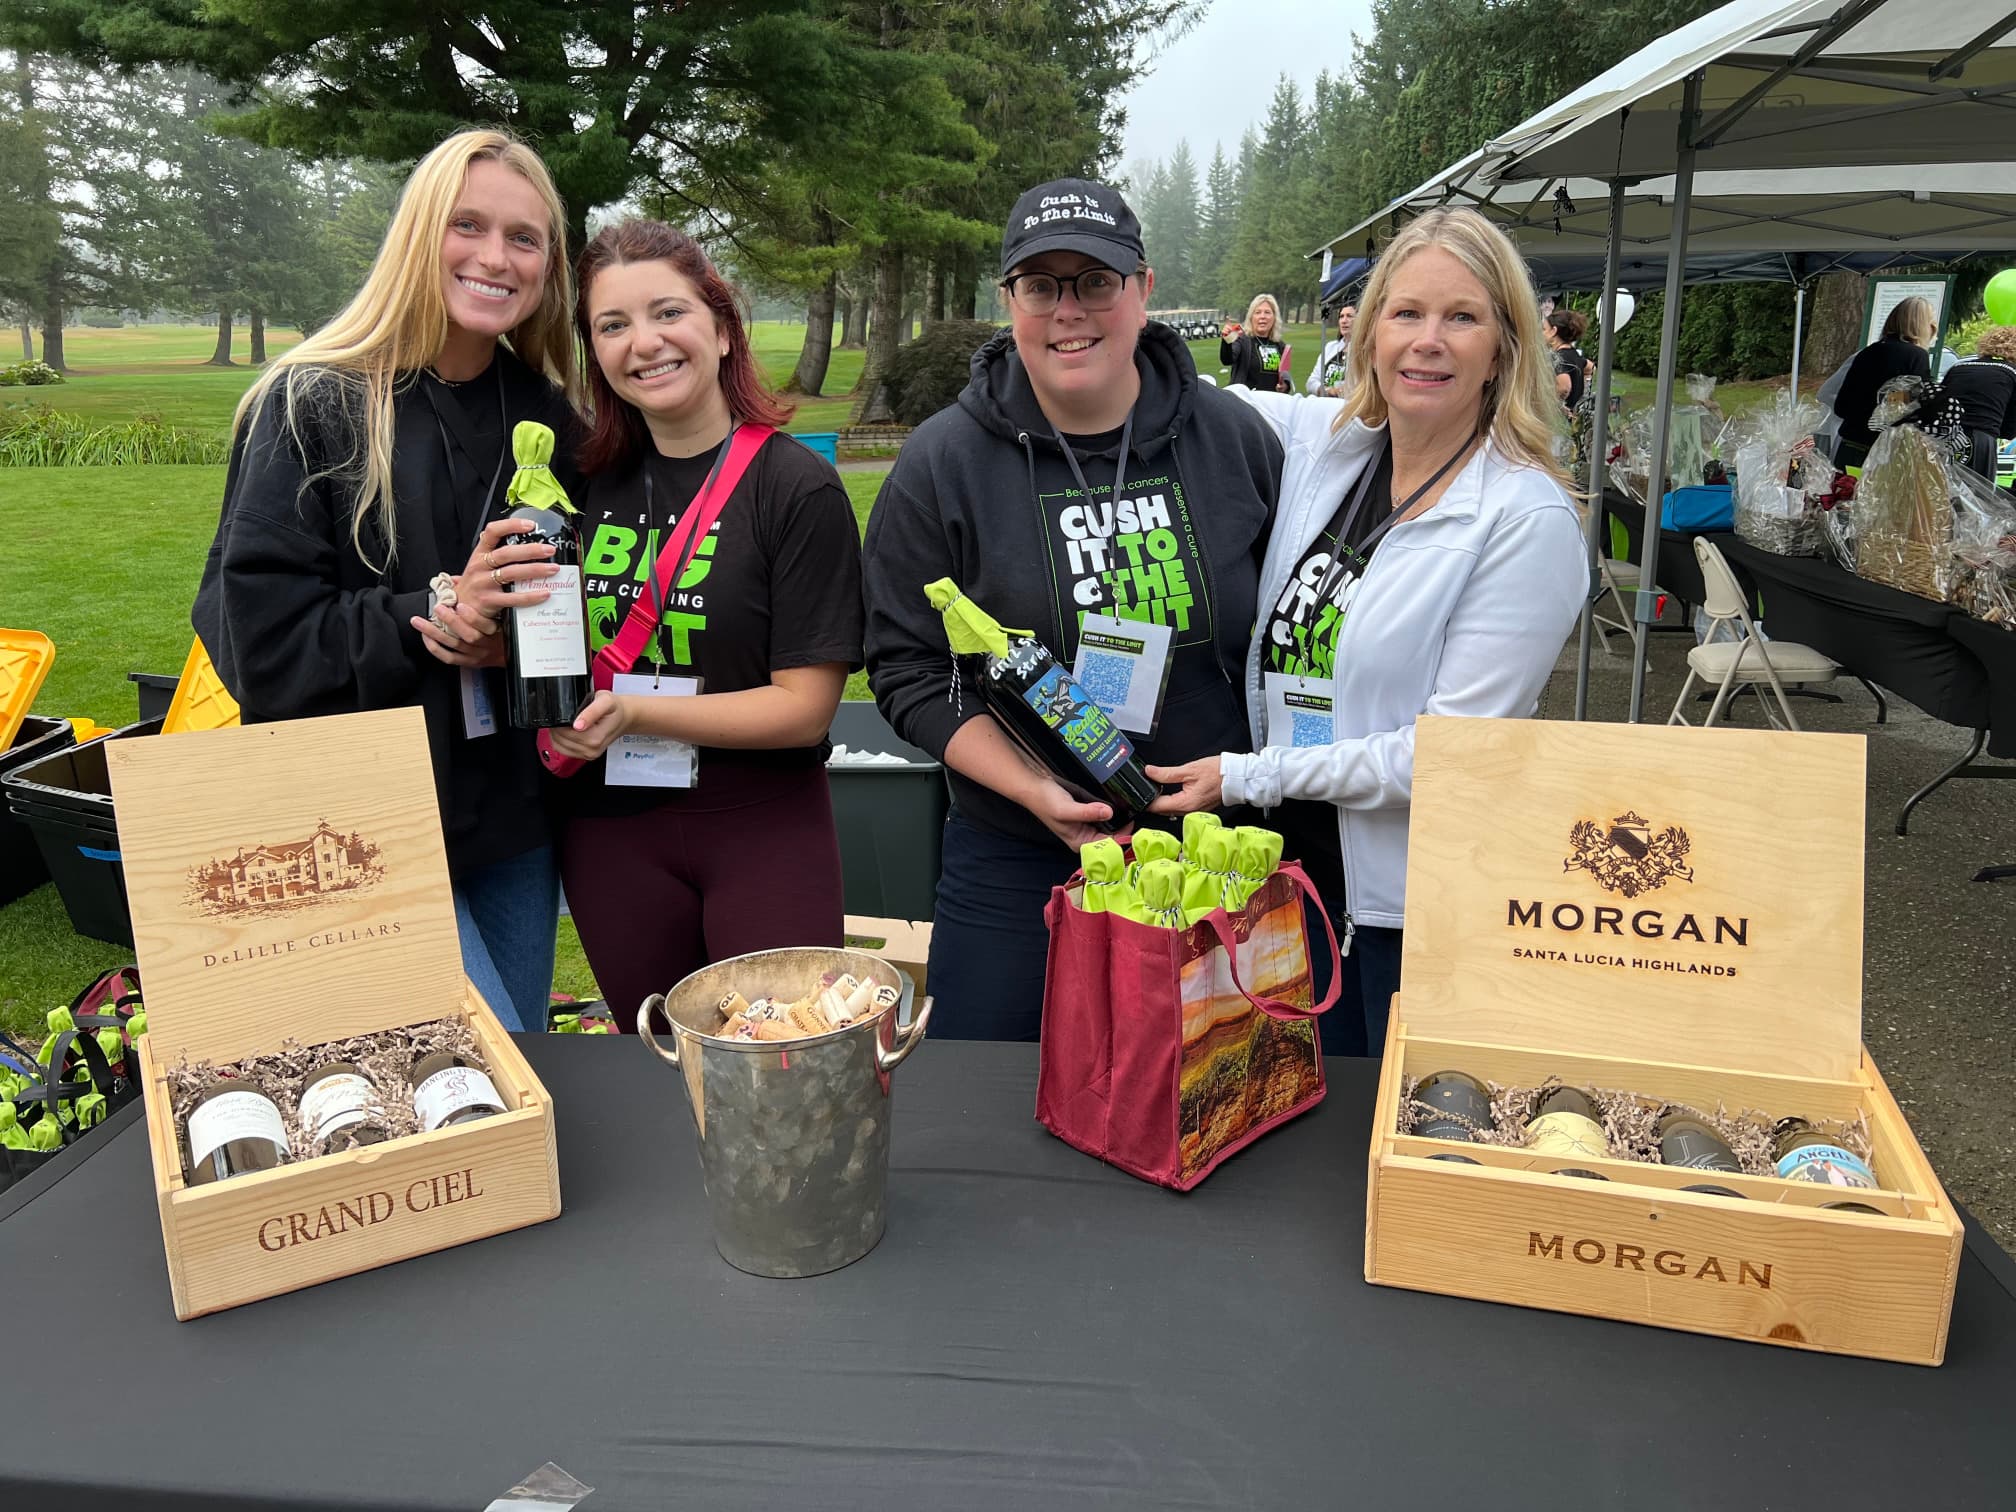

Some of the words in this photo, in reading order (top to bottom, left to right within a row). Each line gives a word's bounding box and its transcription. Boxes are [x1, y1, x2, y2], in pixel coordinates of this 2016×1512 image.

[1024, 216, 1039, 230] To
[1042, 208, 1070, 222] The
[1073, 206, 1116, 225] Limit
[1040, 194, 1081, 208] Cush
[1127, 475, 1169, 490] cancers
[1172, 482, 1189, 522] deserve
[1060, 494, 1172, 540] CUSH
[1184, 524, 1193, 532] a
[1066, 537, 1108, 575] IT
[1116, 527, 1178, 567] TO
[1186, 534, 1199, 558] cure
[618, 583, 704, 609] CUING
[1101, 558, 1191, 605] THE
[1276, 577, 1318, 624] IT
[1073, 713, 1111, 753] SLEW
[309, 921, 402, 948] CELLARS
[1507, 899, 1748, 946] MORGAN
[1513, 948, 1567, 961] SANTA
[1574, 952, 1625, 967] LUCIA
[1632, 957, 1736, 977] HIGHLANDS
[258, 1191, 394, 1252] GRAND
[405, 1168, 483, 1214] CIEL
[1527, 1231, 1773, 1290] MORGAN
